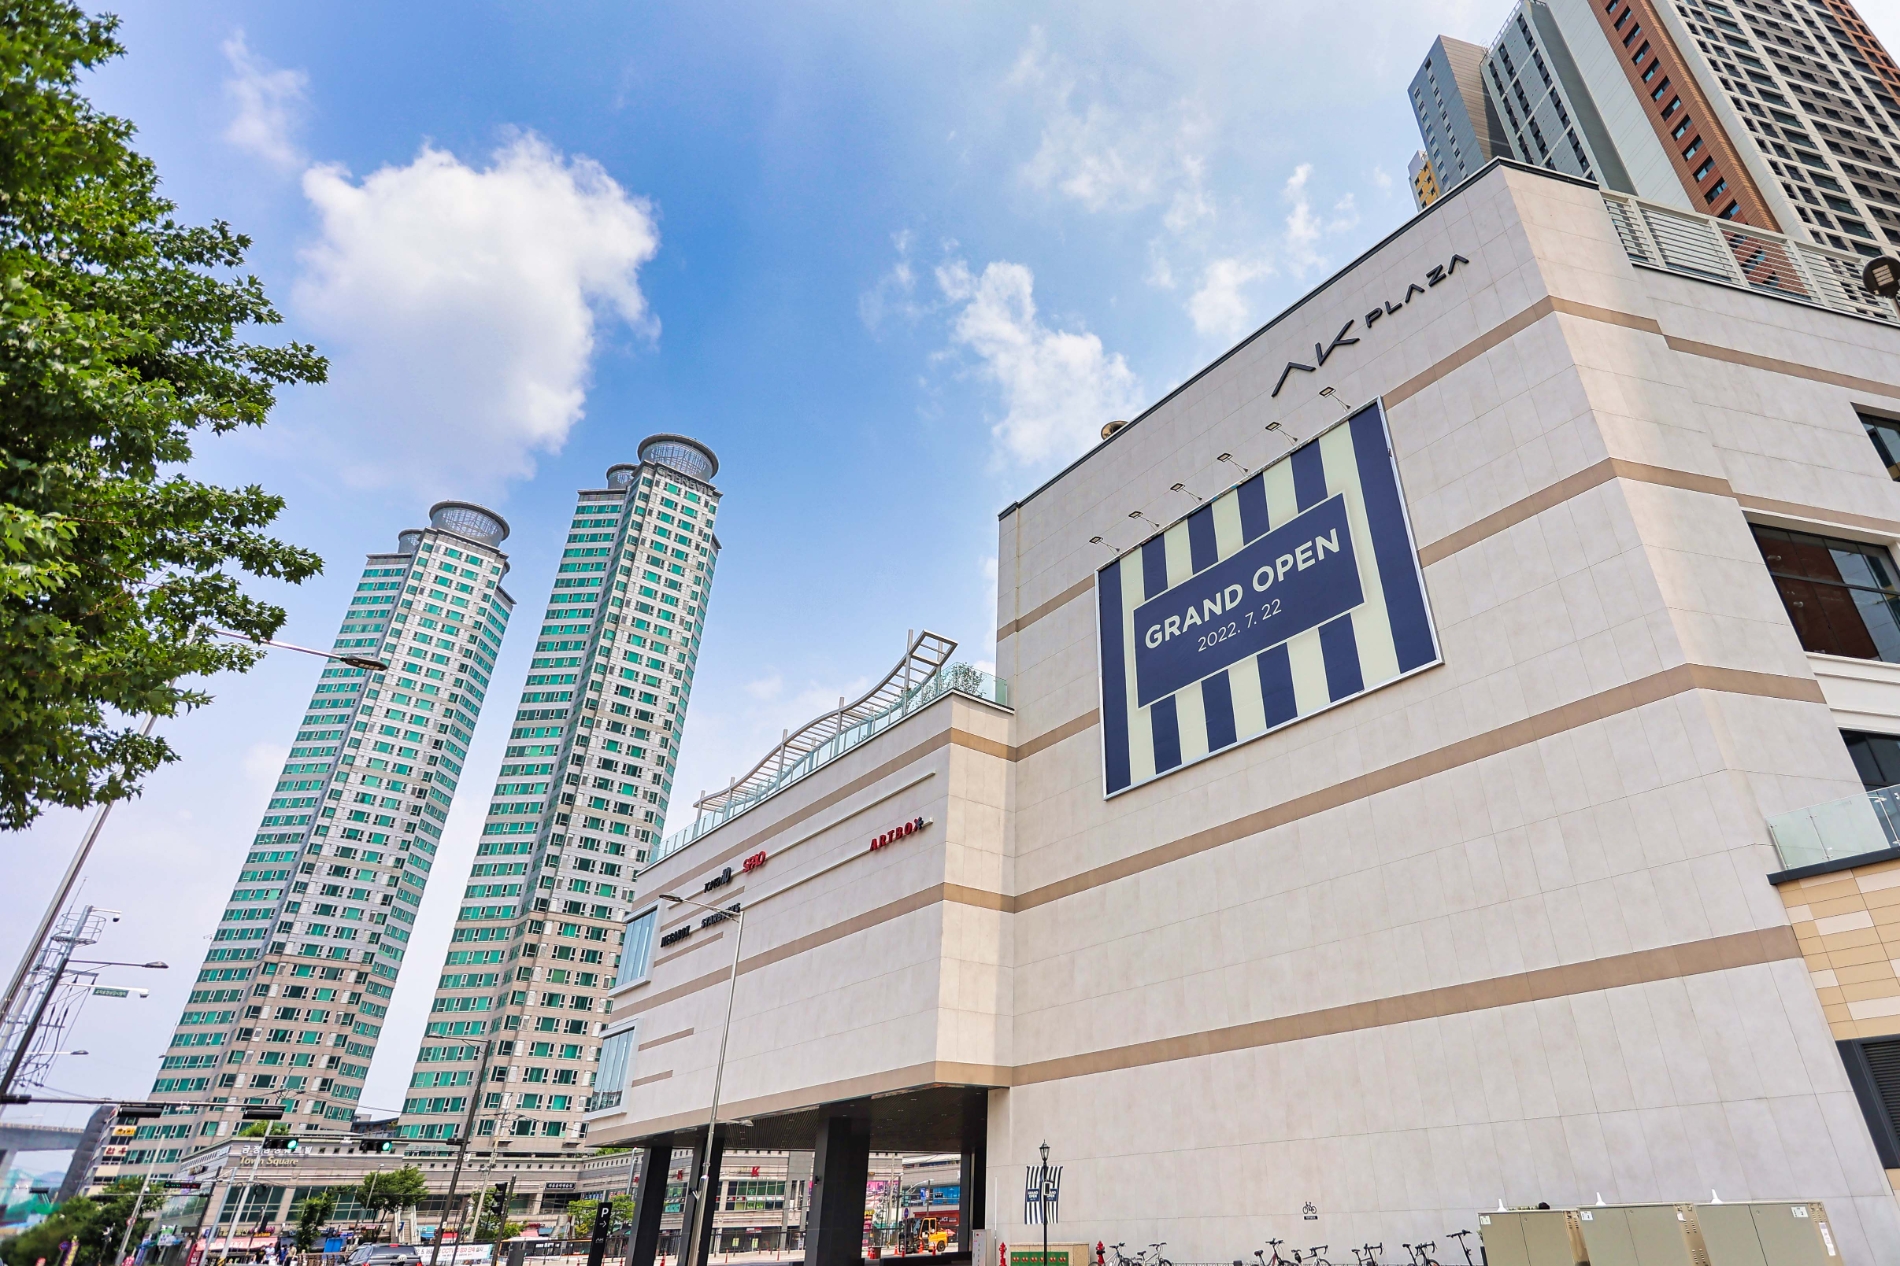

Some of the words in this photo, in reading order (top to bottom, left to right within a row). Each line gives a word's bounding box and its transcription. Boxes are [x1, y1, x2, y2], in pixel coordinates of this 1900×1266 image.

[1271, 319, 1360, 398] AK
[1365, 253, 1470, 329] PLAZA
[1144, 582, 1243, 650] GRAND
[1252, 528, 1340, 593] OPEN
[1197, 620, 1241, 652] 2022.
[1261, 598, 1282, 621] 22
[870, 817, 921, 851] ARTBOX
[266, 1156, 299, 1166] Square
[601, 1207, 609, 1218] P
